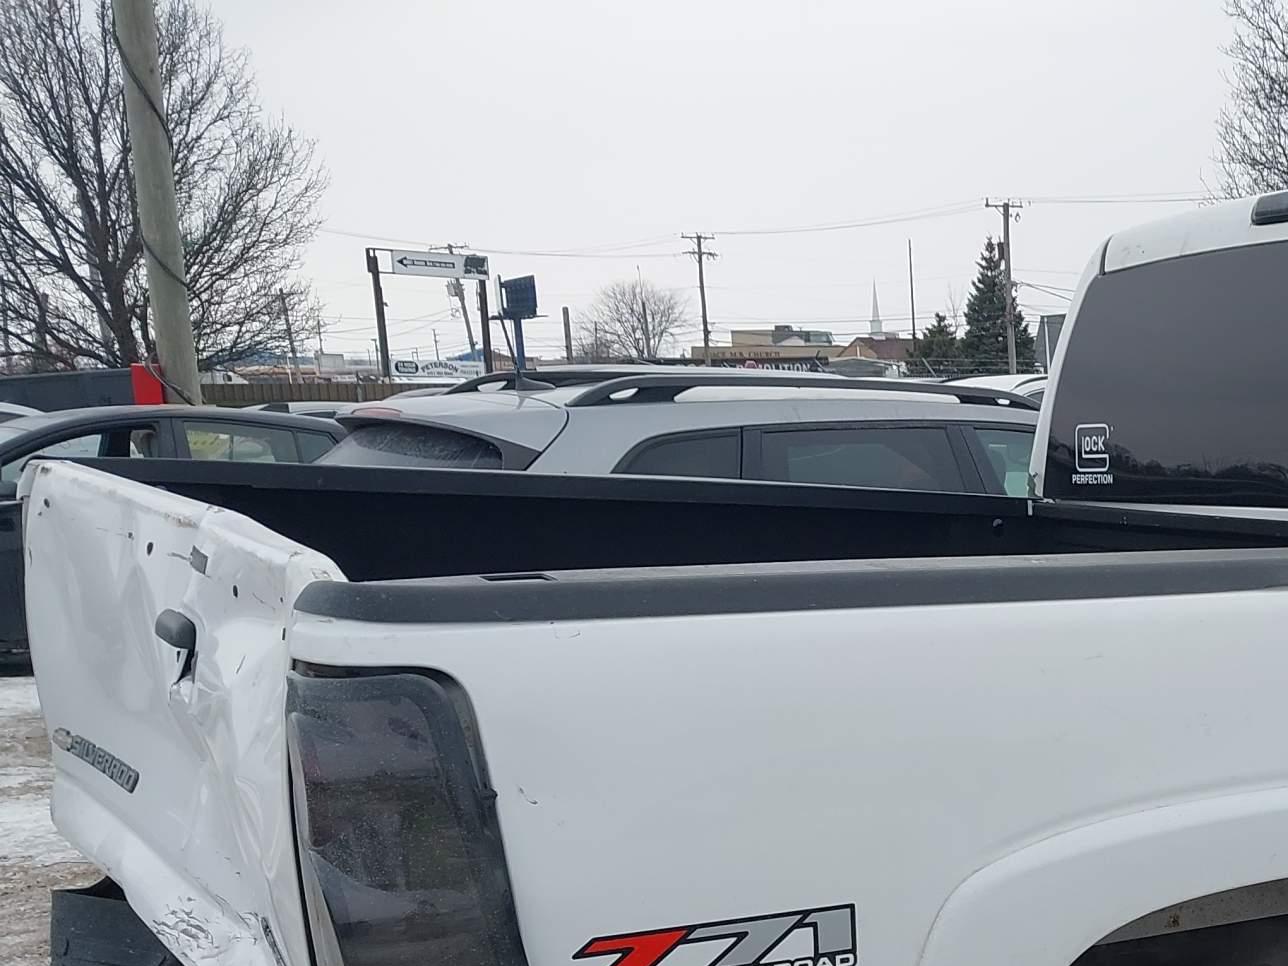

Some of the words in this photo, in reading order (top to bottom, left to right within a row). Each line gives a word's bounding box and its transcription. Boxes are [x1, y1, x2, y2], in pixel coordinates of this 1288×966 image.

[420, 361, 459, 373] PETERSON
[1072, 473, 1113, 485] PERFECTION
[69, 735, 137, 792] SILVERADO
